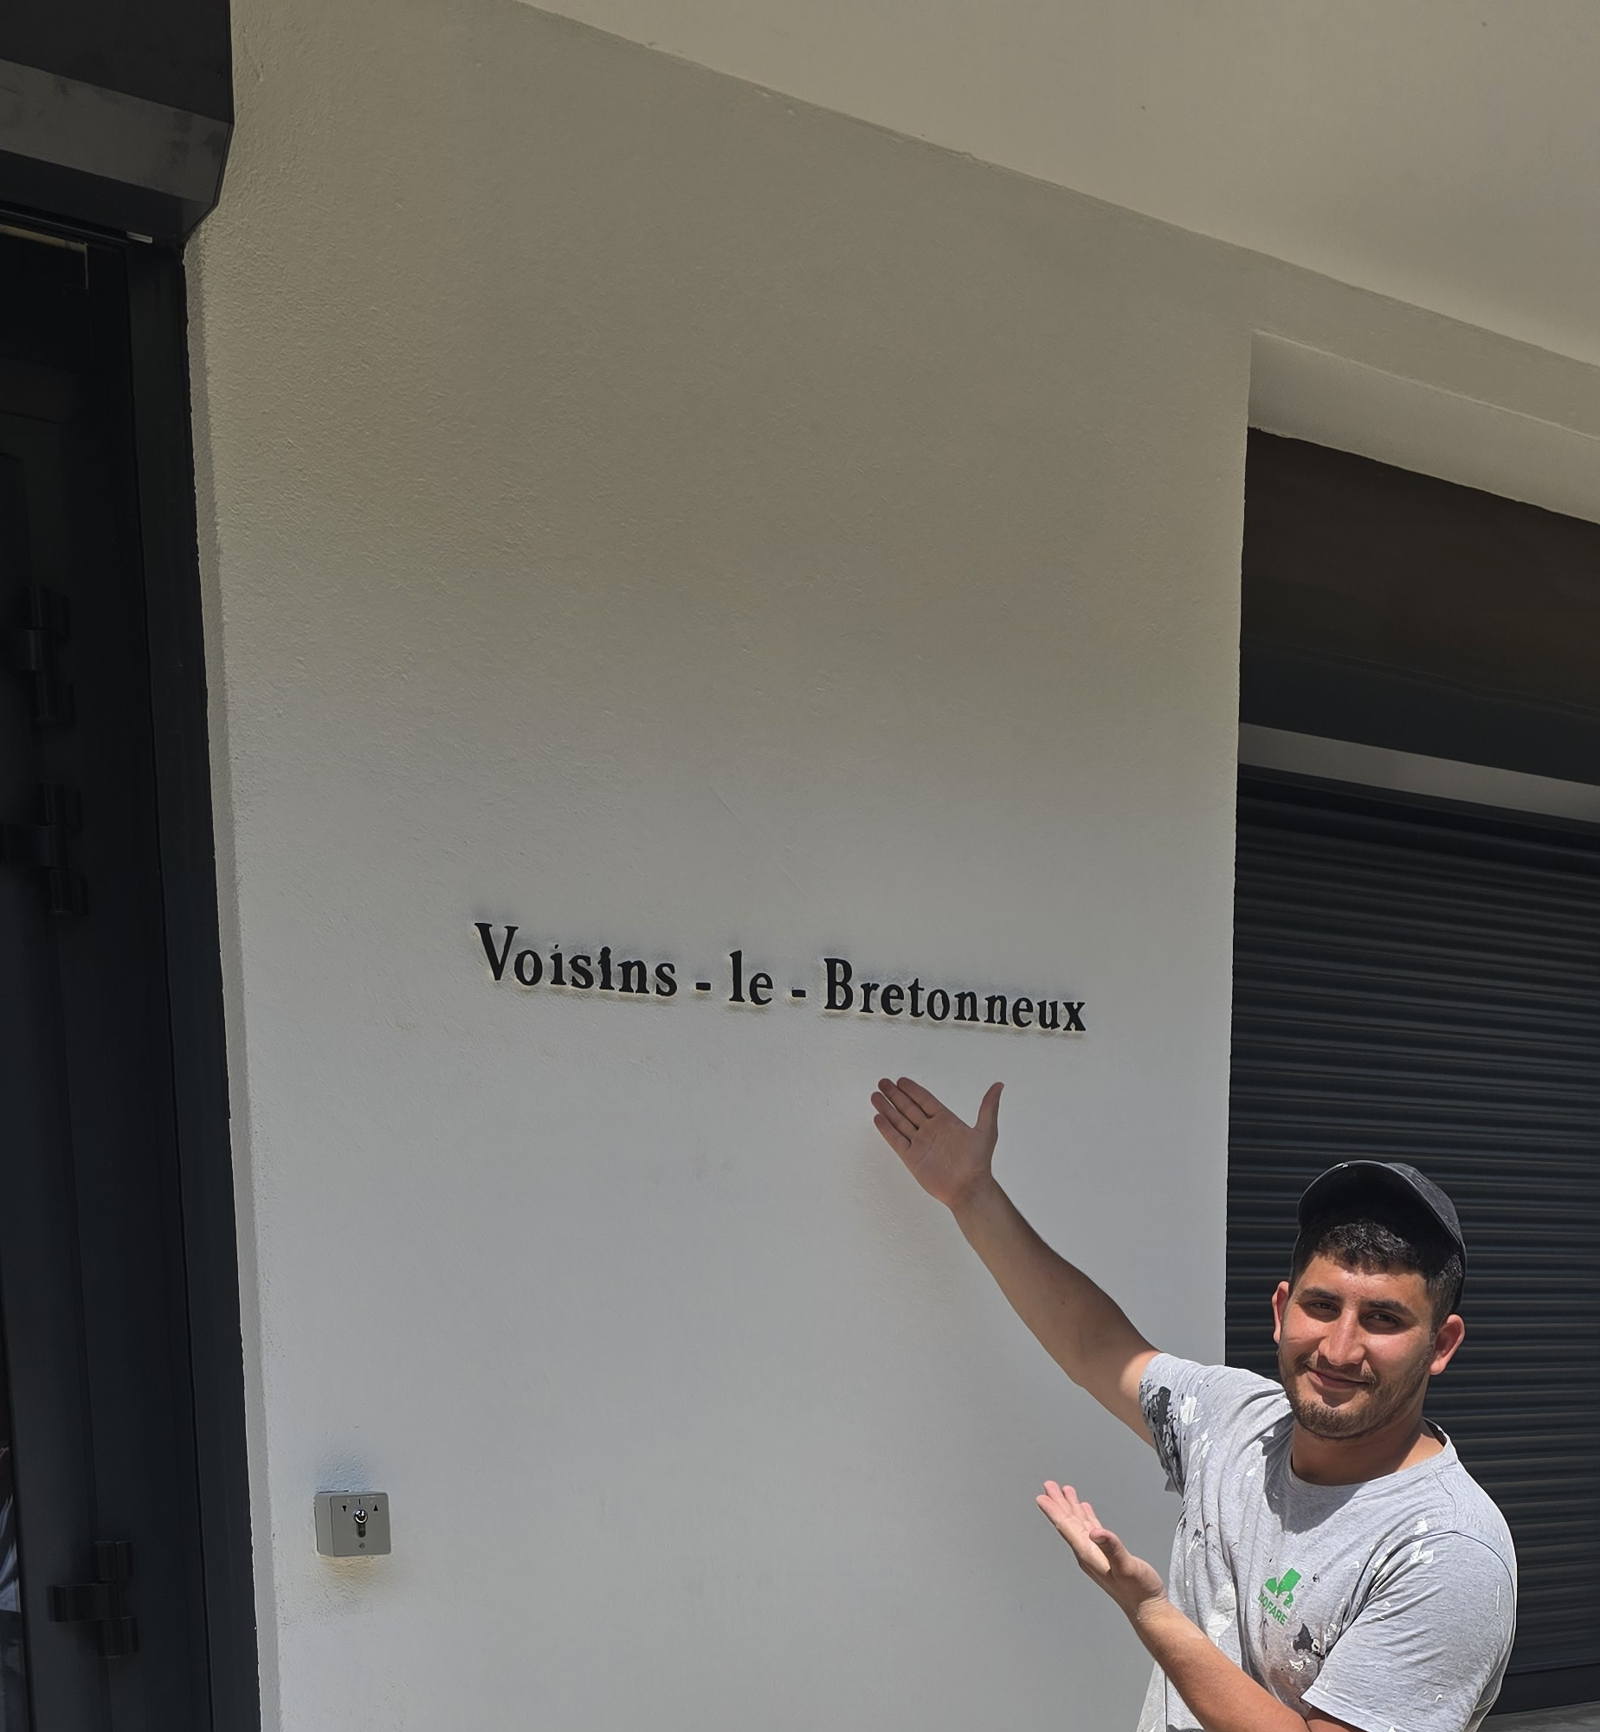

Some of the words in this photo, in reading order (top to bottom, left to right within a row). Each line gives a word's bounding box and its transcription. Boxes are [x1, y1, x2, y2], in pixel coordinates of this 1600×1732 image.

[474, 922, 678, 997] Voisins
[729, 949, 774, 1006] le
[823, 957, 1087, 1033] Bretonneux
